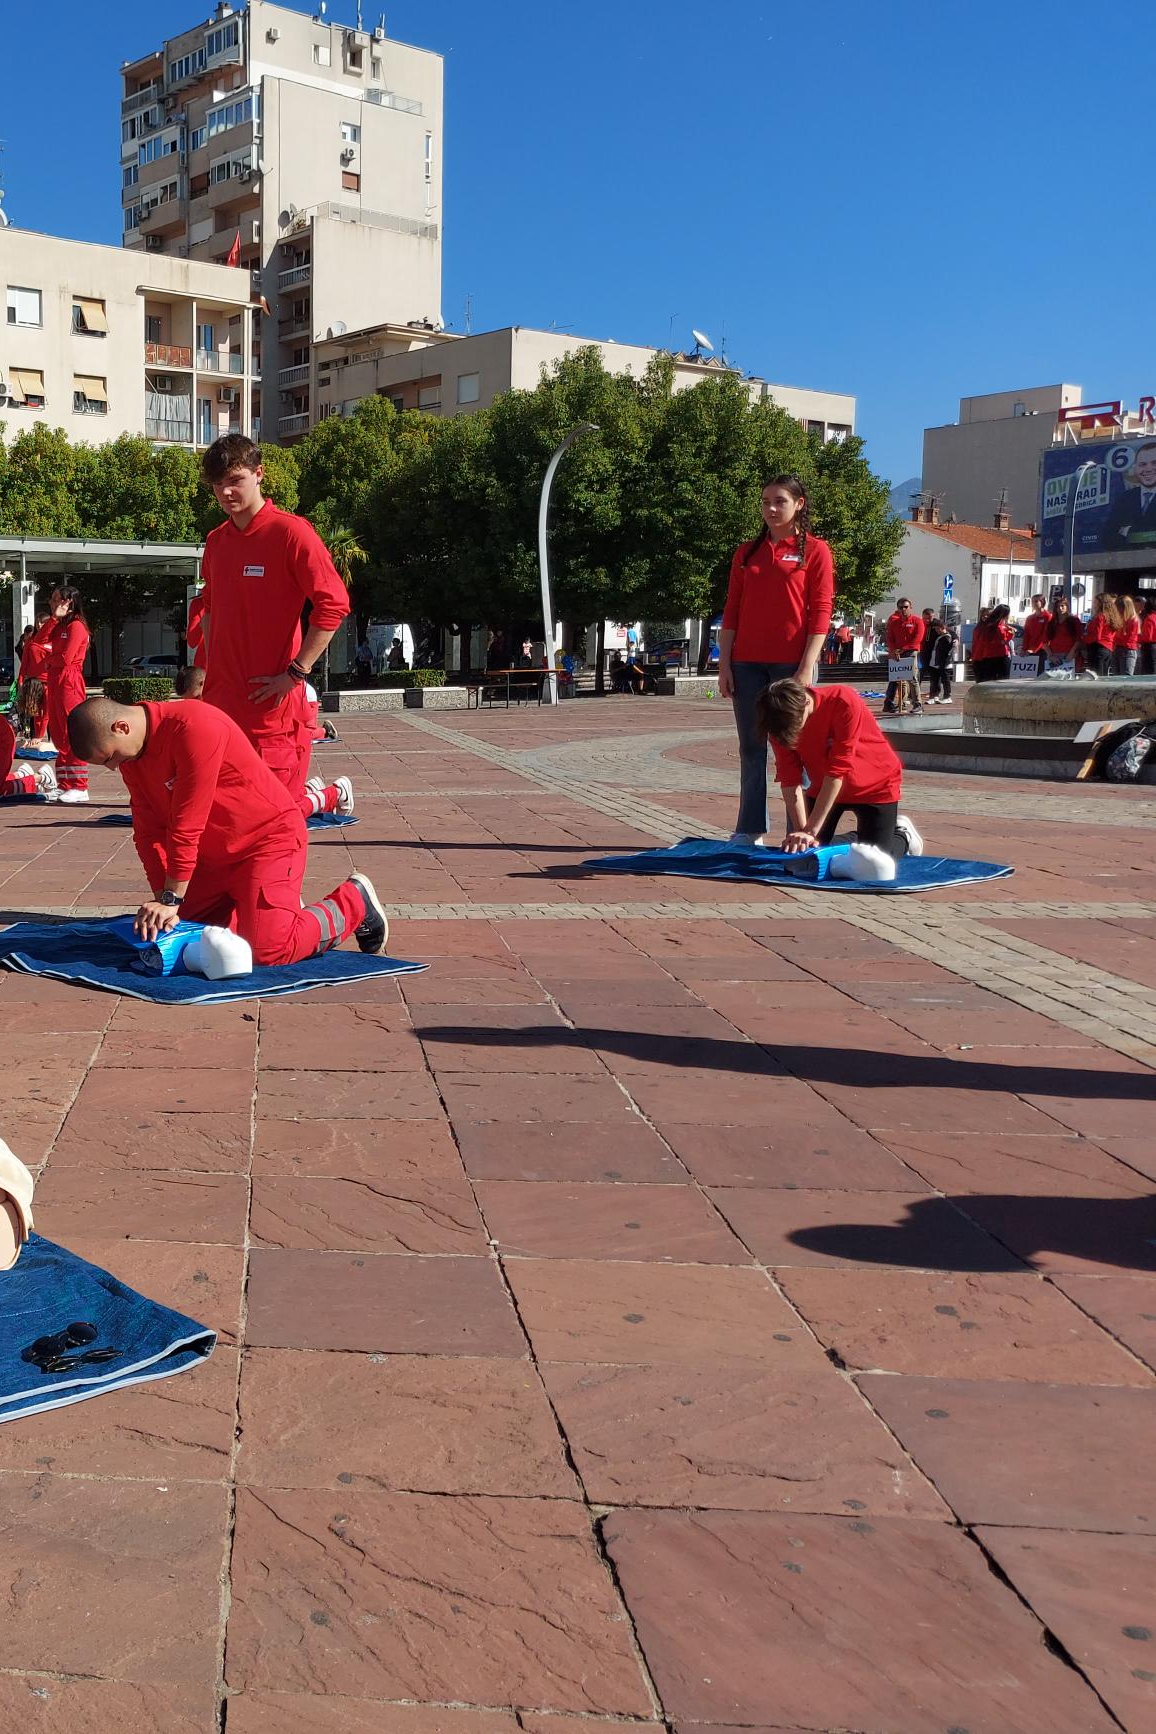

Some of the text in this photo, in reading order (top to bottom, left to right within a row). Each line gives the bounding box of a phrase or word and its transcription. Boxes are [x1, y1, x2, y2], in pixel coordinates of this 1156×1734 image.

[1112, 447, 1129, 468] 6
[1047, 488, 1097, 508] NAŠ RAD
[1012, 663, 1036, 672] TUZI
